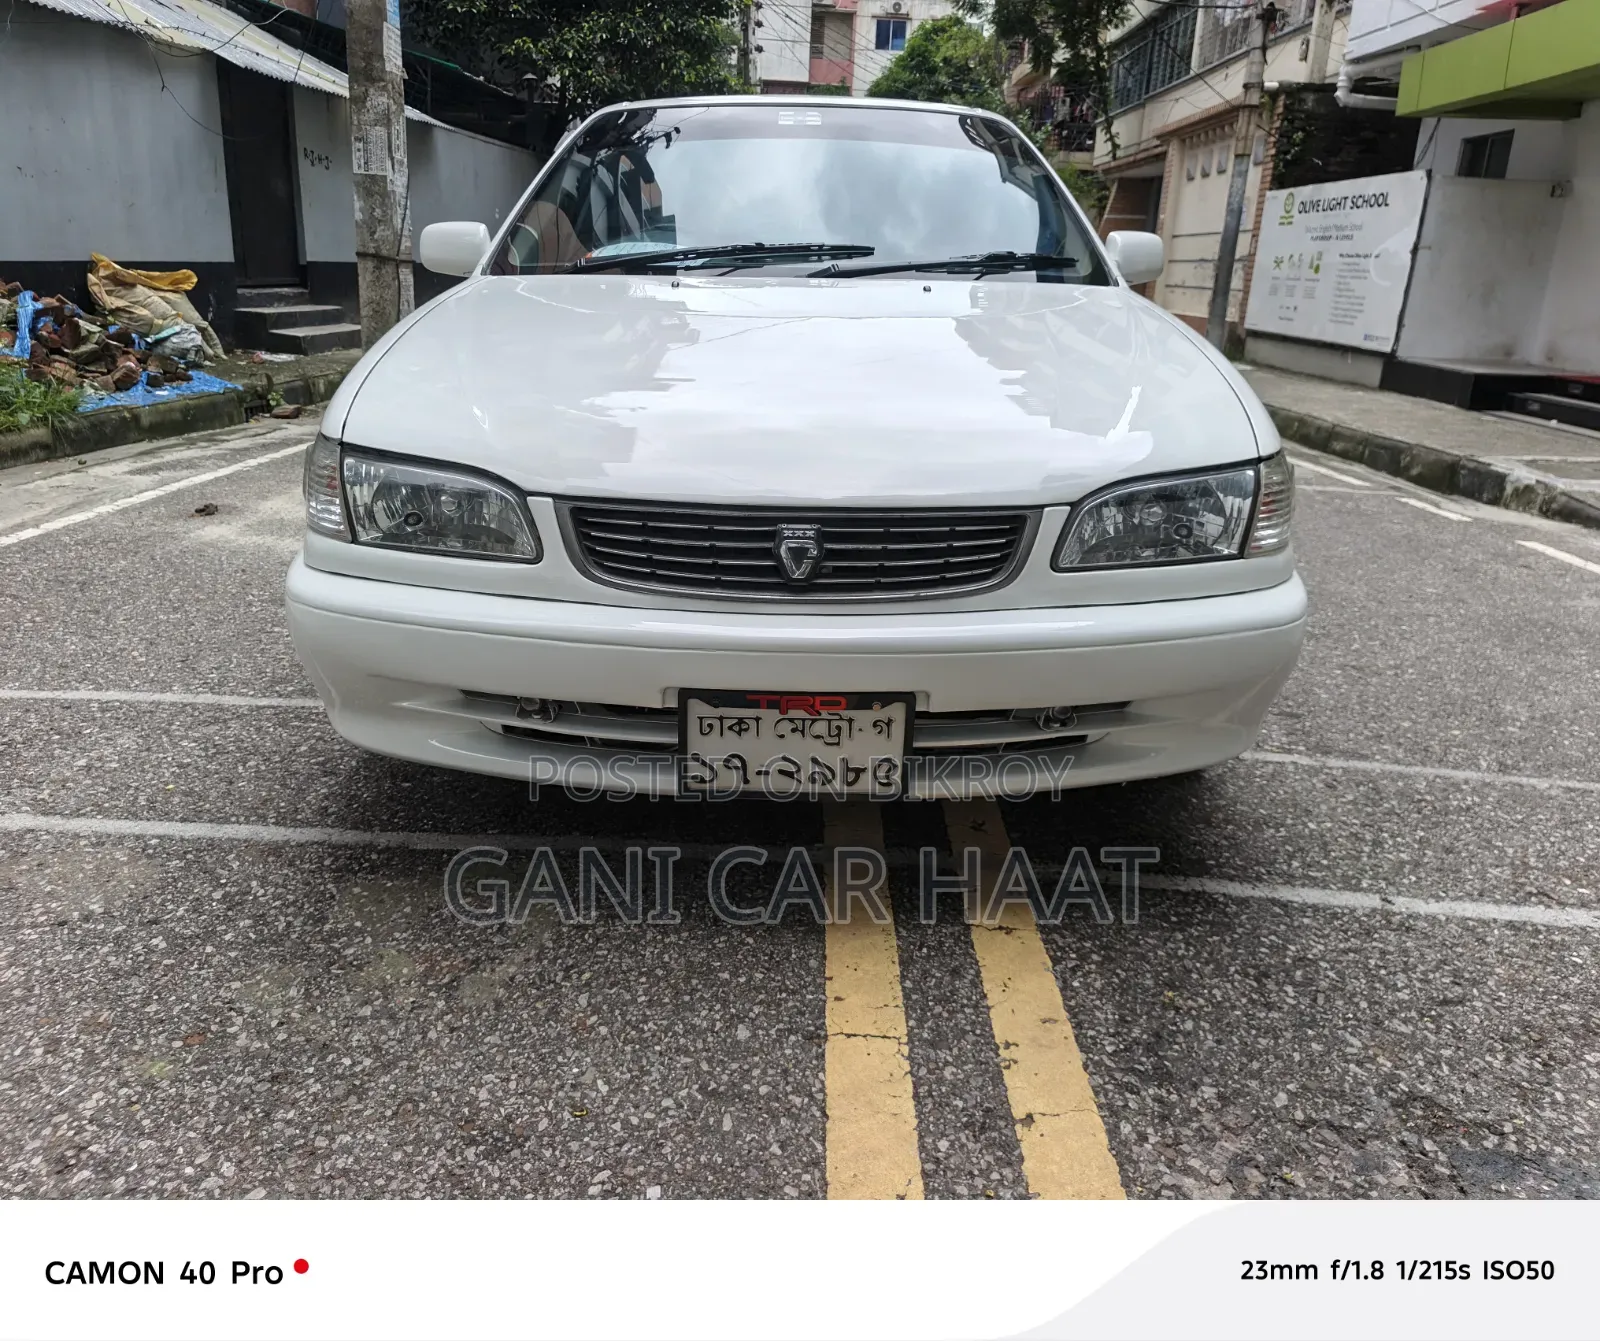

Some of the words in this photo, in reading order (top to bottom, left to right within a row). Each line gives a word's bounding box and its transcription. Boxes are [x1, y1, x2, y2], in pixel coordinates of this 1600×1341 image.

[1298, 199, 1321, 215] OLIVE
[1322, 196, 1348, 212] LIGHT
[1349, 192, 1390, 210] SCHOOL
[746, 694, 848, 716] TRD
[697, 714, 763, 738] ঢাকা
